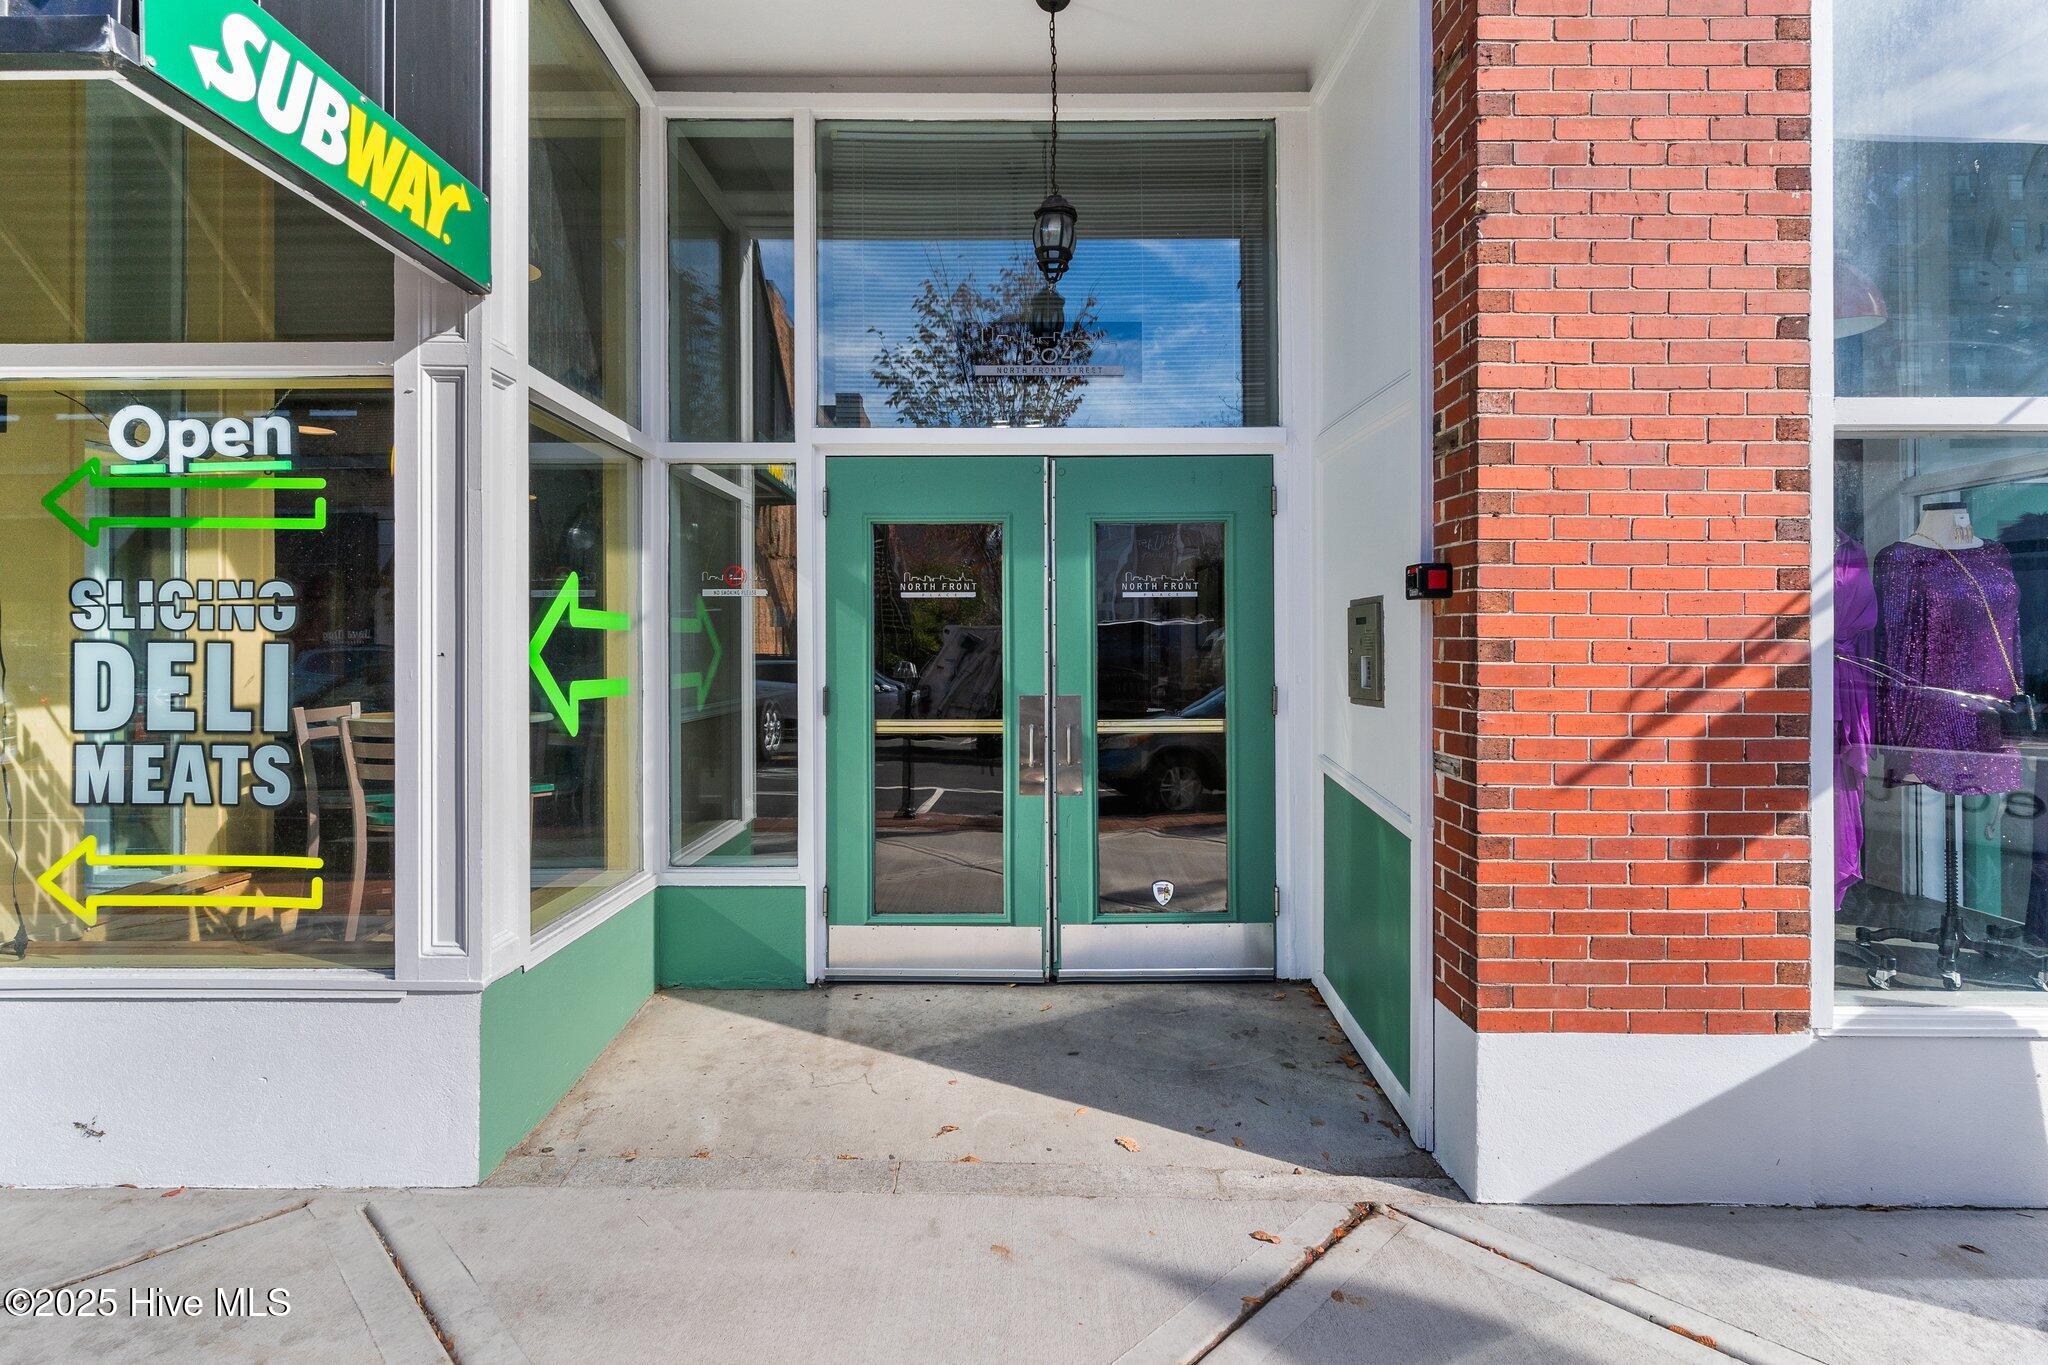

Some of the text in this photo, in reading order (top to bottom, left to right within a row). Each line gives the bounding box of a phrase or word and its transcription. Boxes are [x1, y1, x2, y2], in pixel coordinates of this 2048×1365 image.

[189, 13, 471, 240] SUBWAY
[996, 366, 1103, 374] NORTH FRONT STREET
[109, 405, 292, 473] Open
[70, 579, 297, 632] SLICING
[900, 582, 977, 591] NORTH FRONT
[1121, 582, 1199, 591] NORTH FRONT
[73, 642, 290, 733] DELI
[74, 744, 291, 806] MEATS
